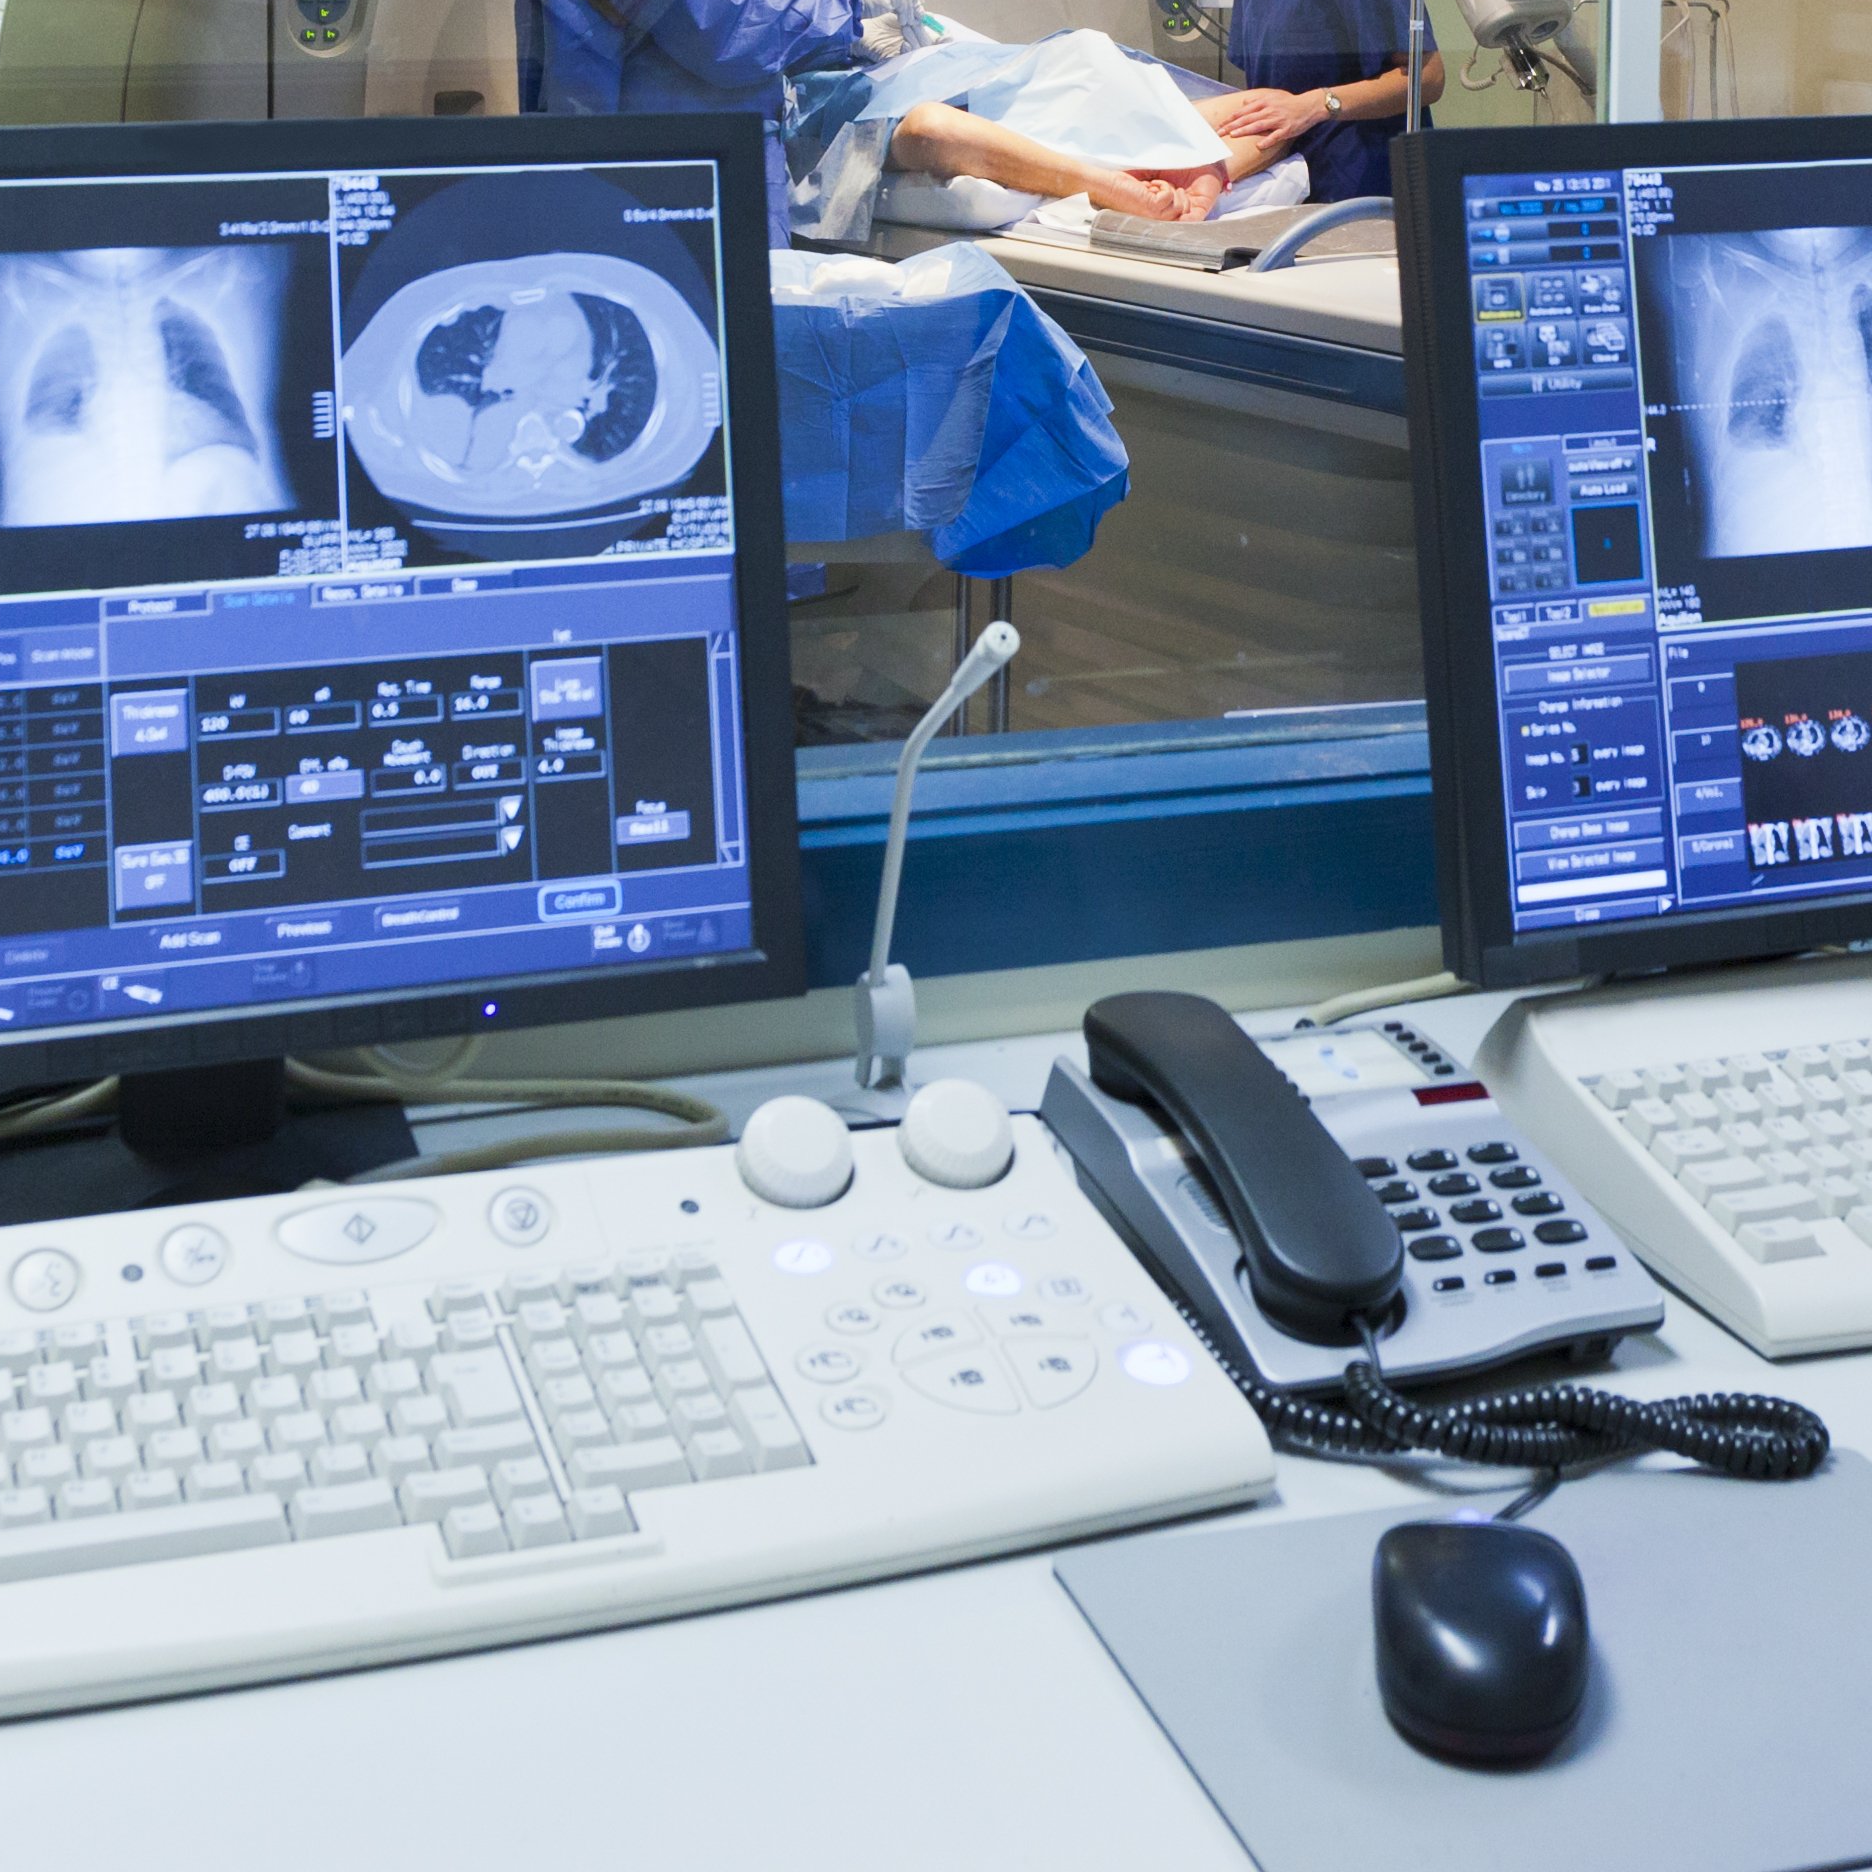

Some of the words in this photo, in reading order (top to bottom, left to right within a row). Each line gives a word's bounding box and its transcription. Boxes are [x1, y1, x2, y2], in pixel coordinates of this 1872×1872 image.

[1580, 484, 1603, 497] Auto
[1604, 483, 1628, 496] Load
[554, 891, 606, 911] Confirm
[159, 932, 185, 950] Add
[187, 929, 221, 948] Scan
